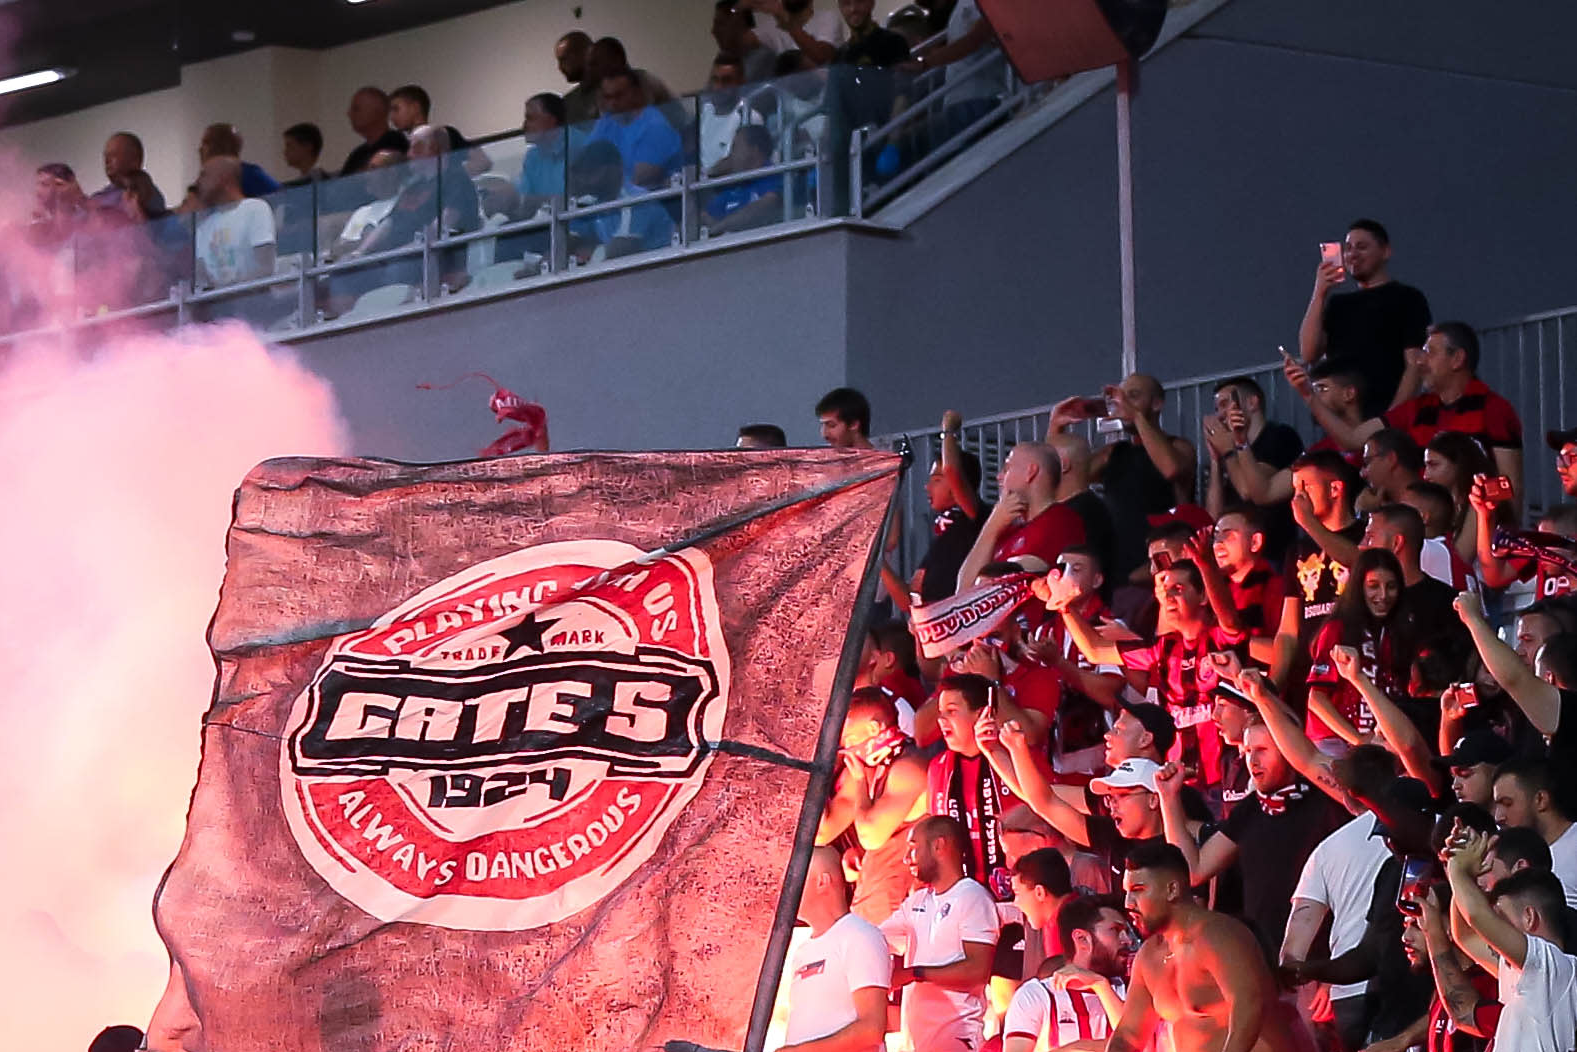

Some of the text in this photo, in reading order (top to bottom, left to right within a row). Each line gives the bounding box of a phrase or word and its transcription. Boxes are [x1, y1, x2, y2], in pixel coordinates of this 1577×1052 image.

[383, 580, 678, 655] PLAYING US
[441, 630, 605, 662] TRADE MARK
[427, 768, 572, 808] 1924
[338, 786, 642, 887] ALWAYS DANGEROUS
